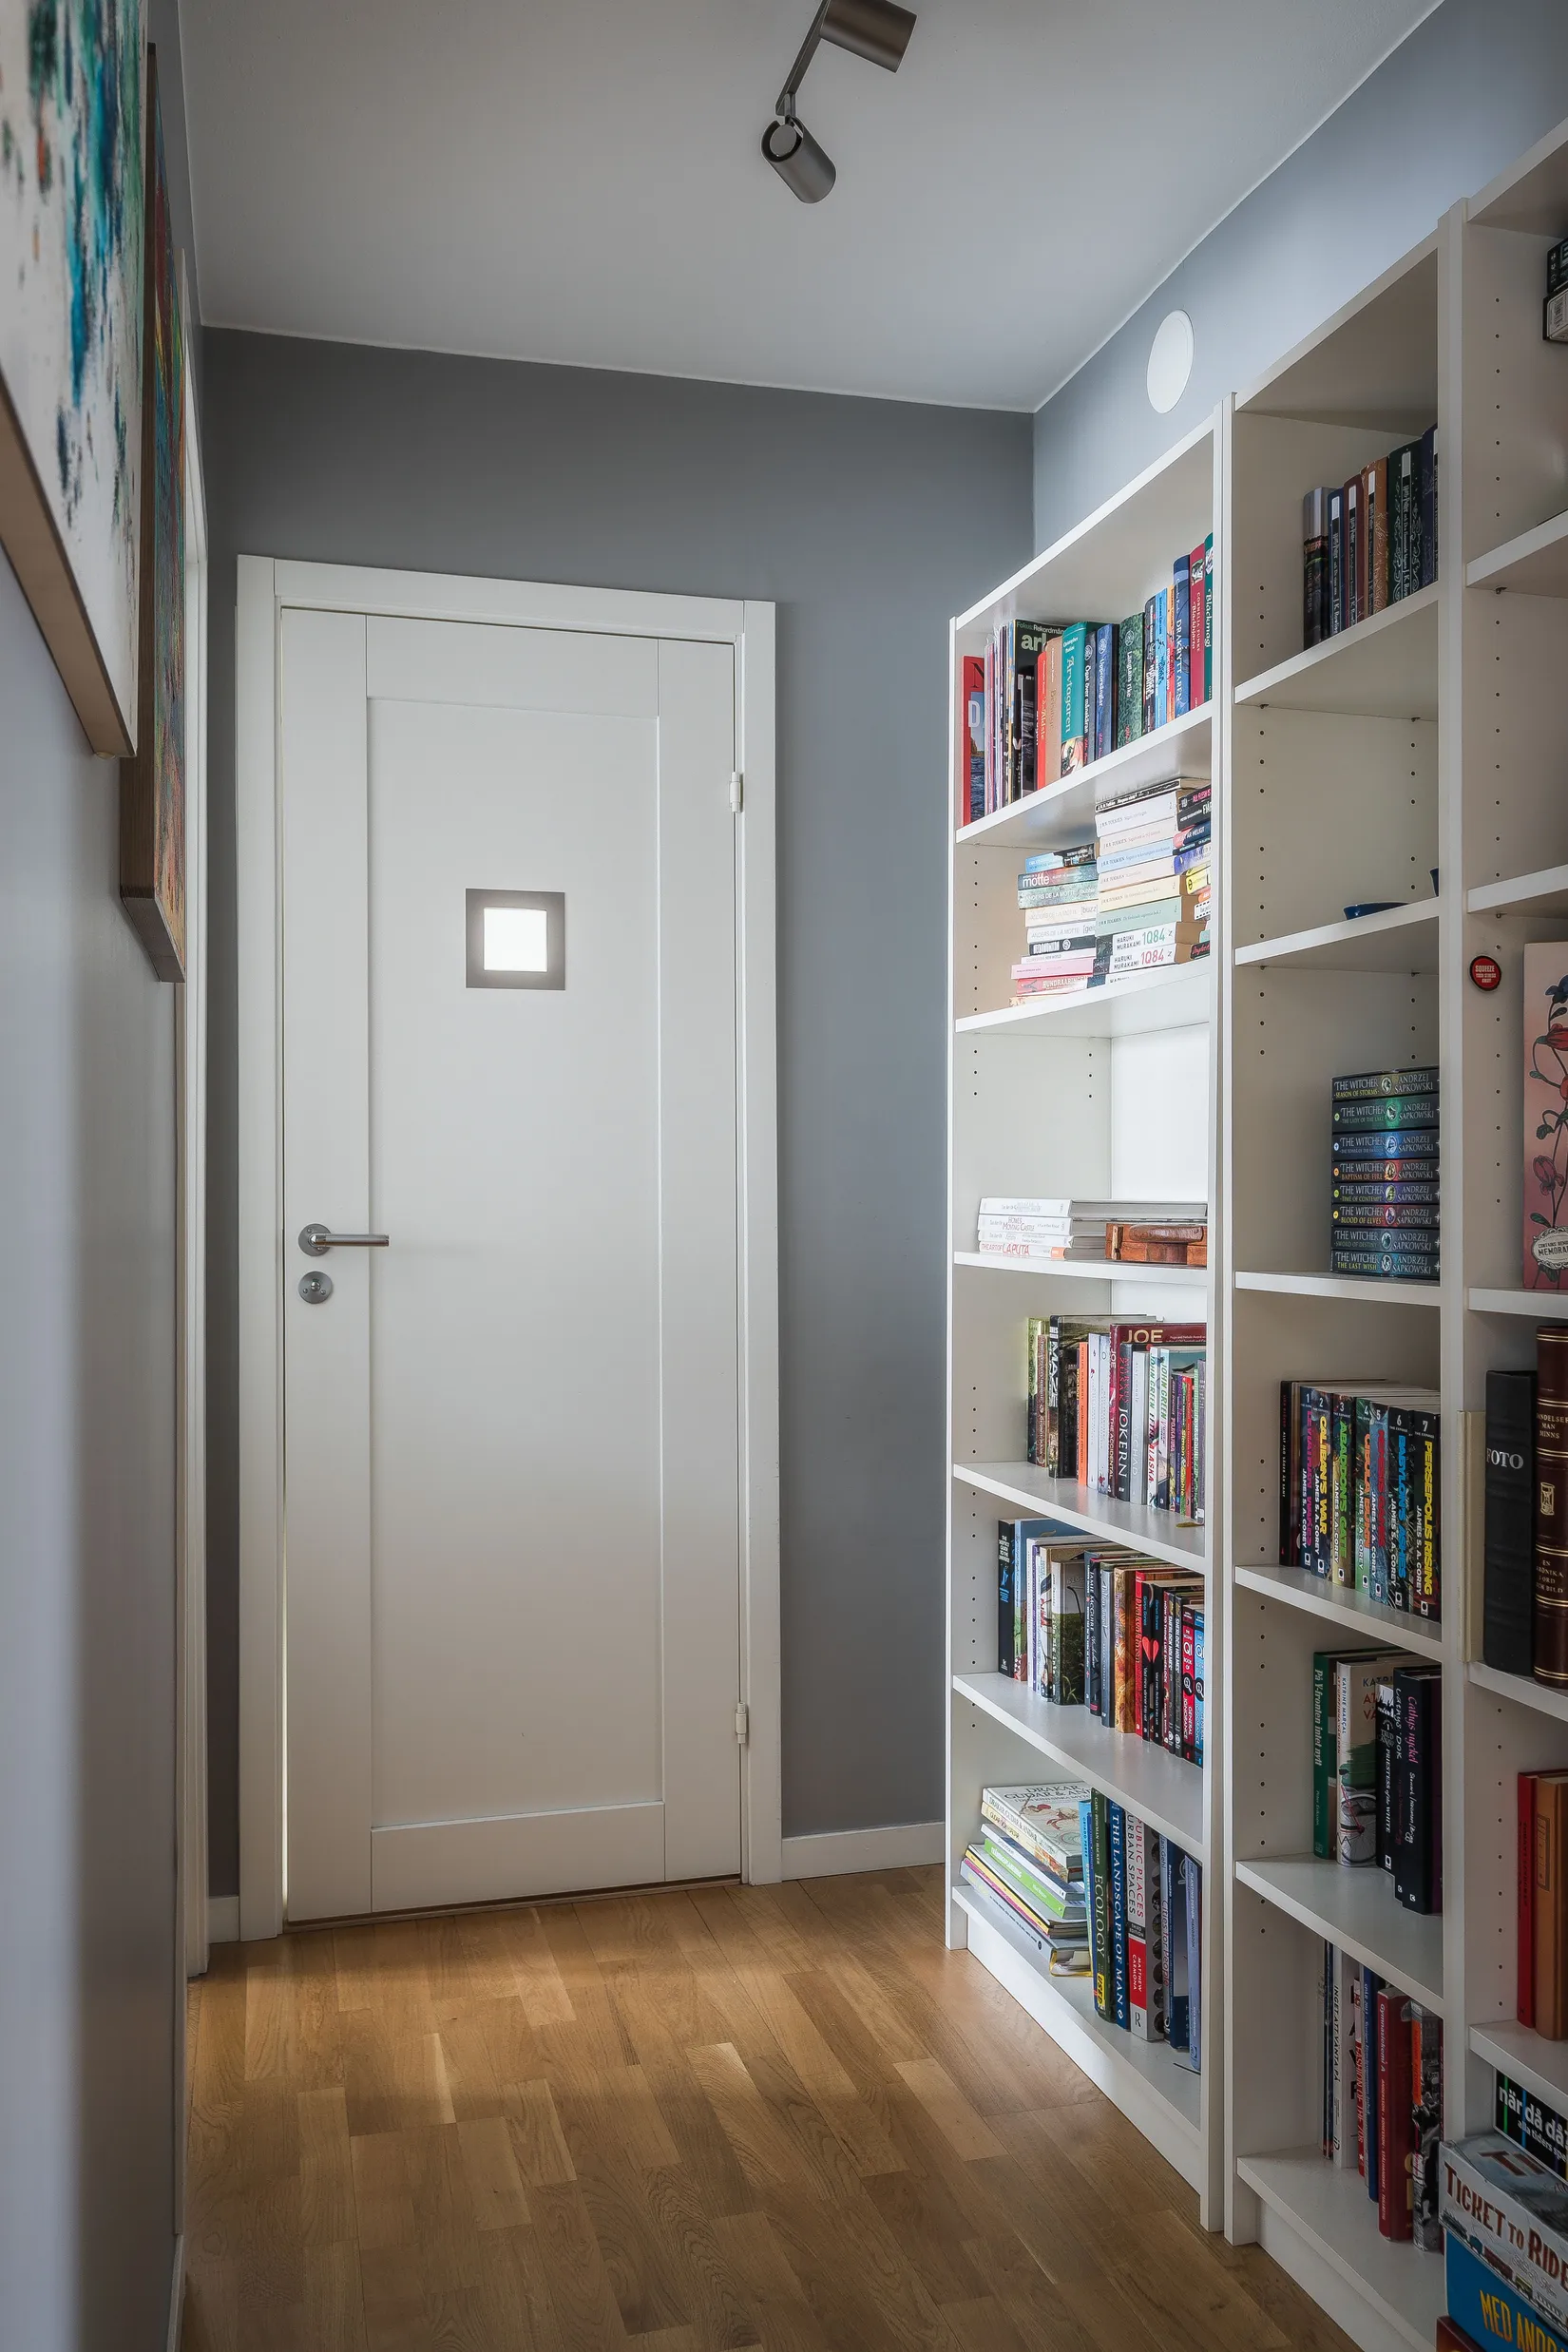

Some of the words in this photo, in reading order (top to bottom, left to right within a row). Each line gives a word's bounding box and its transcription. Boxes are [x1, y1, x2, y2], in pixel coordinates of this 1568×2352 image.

[1023, 873, 1050, 888] motte
[1142, 928, 1165, 945] 1Q84
[1141, 948, 1164, 965] 1Q84
[1334, 1080, 1349, 1090] THE
[1350, 1079, 1378, 1089] WITCHER
[1399, 1073, 1429, 1084] ANDRZEJ
[1395, 1082, 1433, 1094] SAPKOWSKI
[1340, 1207, 1355, 1216] THE
[1356, 1207, 1384, 1216] WITCHER
[1397, 1217, 1432, 1225] SAPKOWSKI
[1002, 1243, 1030, 1256] LAPUTA
[1335, 1252, 1349, 1261] THE
[1350, 1253, 1379, 1263] WITCHER
[1398, 1255, 1427, 1265] ANDRZEJ
[1392, 1263, 1431, 1274] SAPKOWSKI
[1122, 1329, 1163, 1343] JOE
[1306, 1394, 1309, 1403] 1
[1319, 1398, 1323, 1407] 2
[1340, 1402, 1344, 1411] 3
[1364, 1406, 1368, 1415] 4
[1376, 1410, 1380, 1420] 5
[1397, 1415, 1401, 1425] 6
[1423, 1420, 1428, 1432] 7
[1119, 1407, 1128, 1477] JOKERN
[1486, 1448, 1524, 1469] FOTO
[1425, 1440, 1433, 1539] PERSEPOLIS
[1315, 1669, 1323, 1681] På
[1315, 1683, 1323, 1725] Y-fronten
[1113, 1849, 1122, 1940] LANDSCAPE
[1095, 1874, 1104, 1958] ECOLOGY
[1115, 1944, 1122, 1963] OF
[1499, 2086, 1523, 2115] när
[1525, 2103, 1543, 2131] då
[1518, 2120, 1531, 2136] alla
[1532, 2128, 1553, 2152] tiders
[1444, 2161, 1506, 2240] TICKET
[1508, 2221, 1524, 2251] TO
[1479, 2290, 1512, 2342] MED
